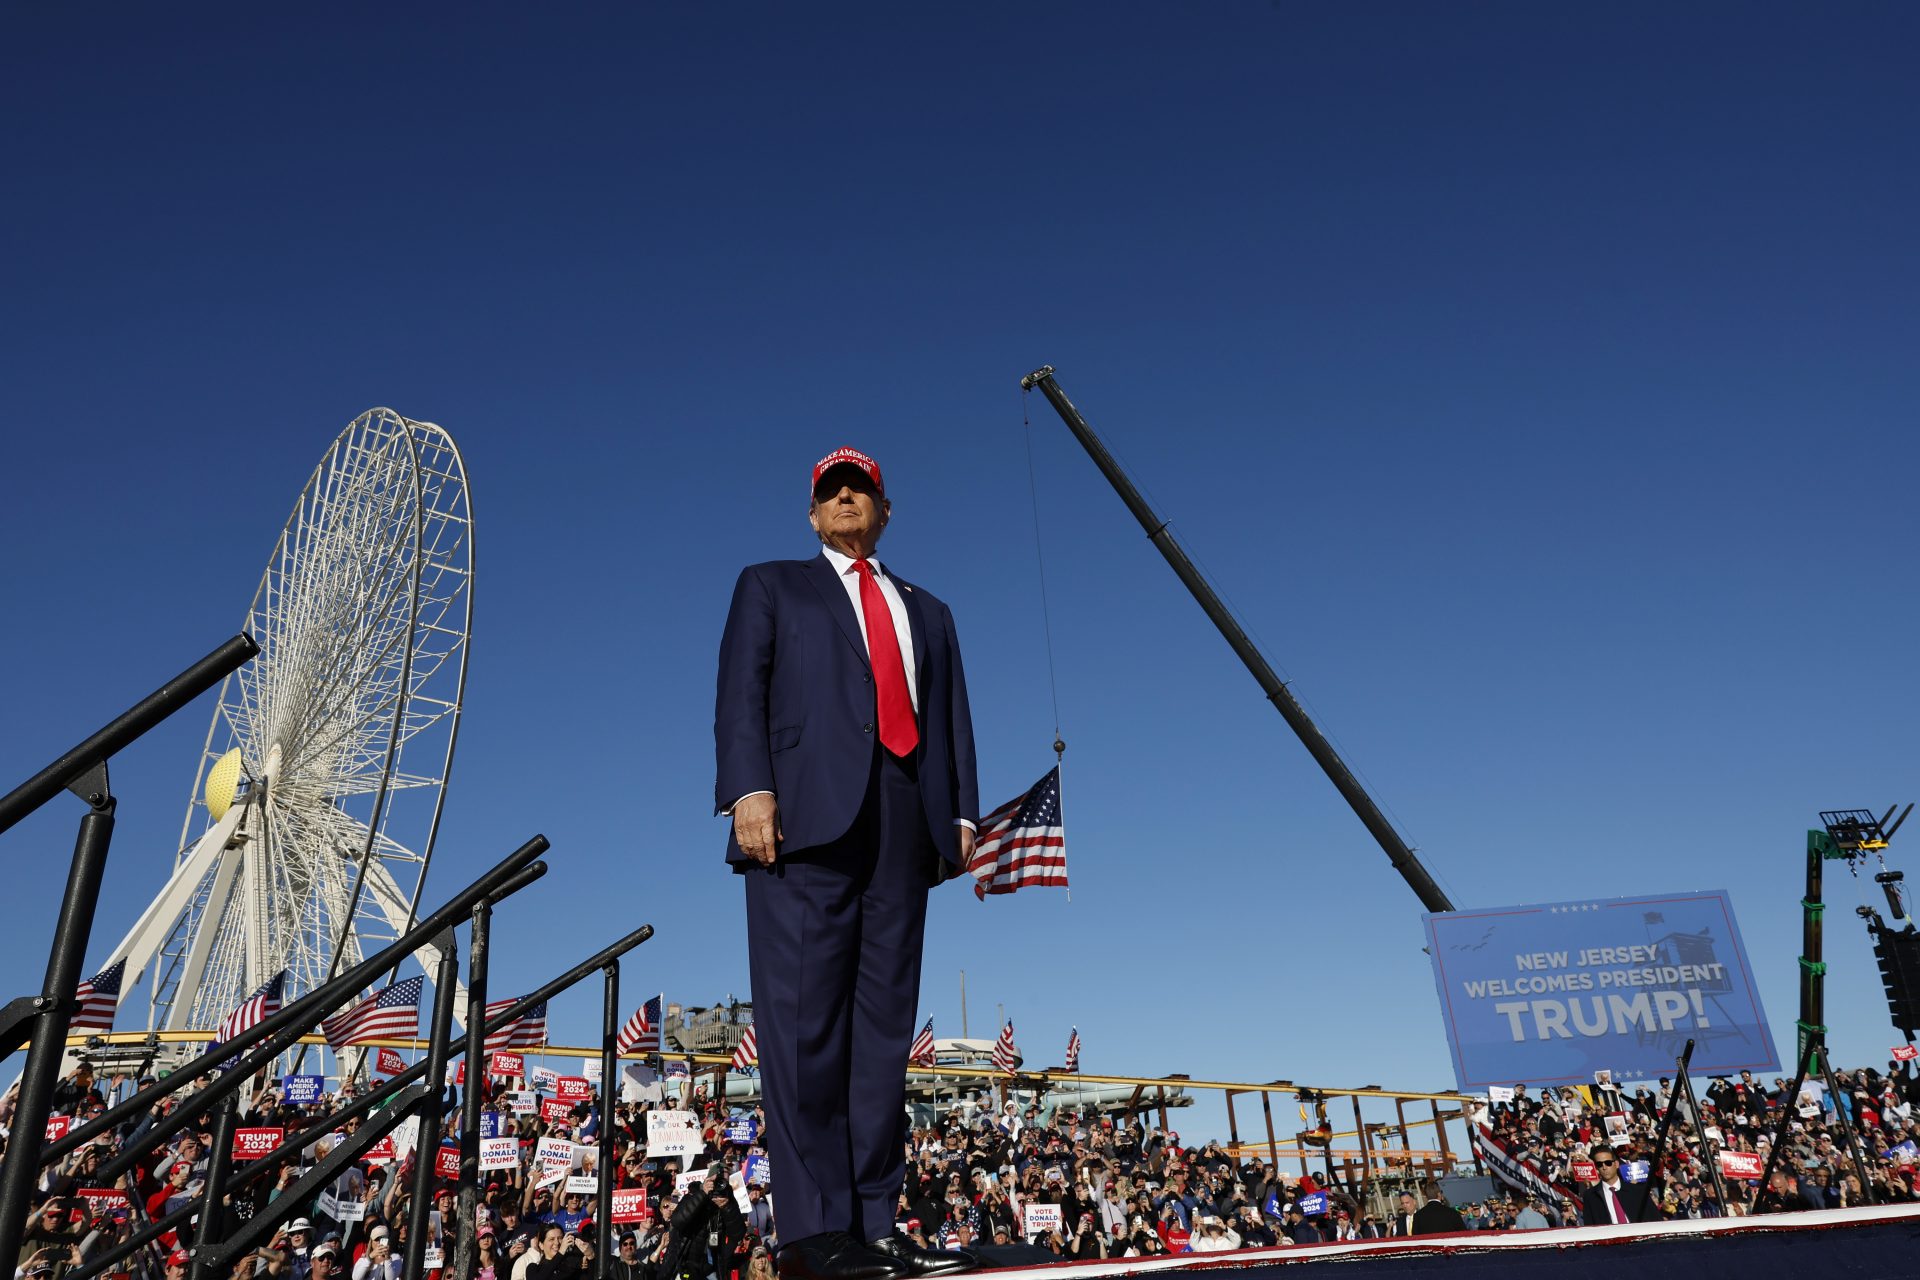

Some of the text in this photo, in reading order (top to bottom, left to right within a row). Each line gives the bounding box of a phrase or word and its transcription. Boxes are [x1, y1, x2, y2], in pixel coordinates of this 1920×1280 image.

[816, 449, 876, 467] MAKE AMERICA
[1515, 944, 1658, 971] NEW JERSEY
[1463, 963, 1723, 999] WELCOMES PRESIDENT
[1495, 988, 1711, 1042] TRUMP!
[383, 1060, 401, 1069] 2024
[495, 1056, 522, 1064] TRUMP
[546, 1102, 573, 1111] TRUMP
[548, 1109, 568, 1117] 2024
[238, 1133, 279, 1142] TRUMP
[243, 1141, 273, 1150] 2024
[548, 1143, 571, 1152] VOTE
[482, 1149, 517, 1157] DONALD
[540, 1149, 572, 1159] DONAL
[542, 1157, 571, 1166] TRUMP
[612, 1194, 643, 1204] RUMP
[1299, 1198, 1323, 1206] TRUMP
[612, 1203, 637, 1213] 2024
[1302, 1204, 1320, 1212] 2024
